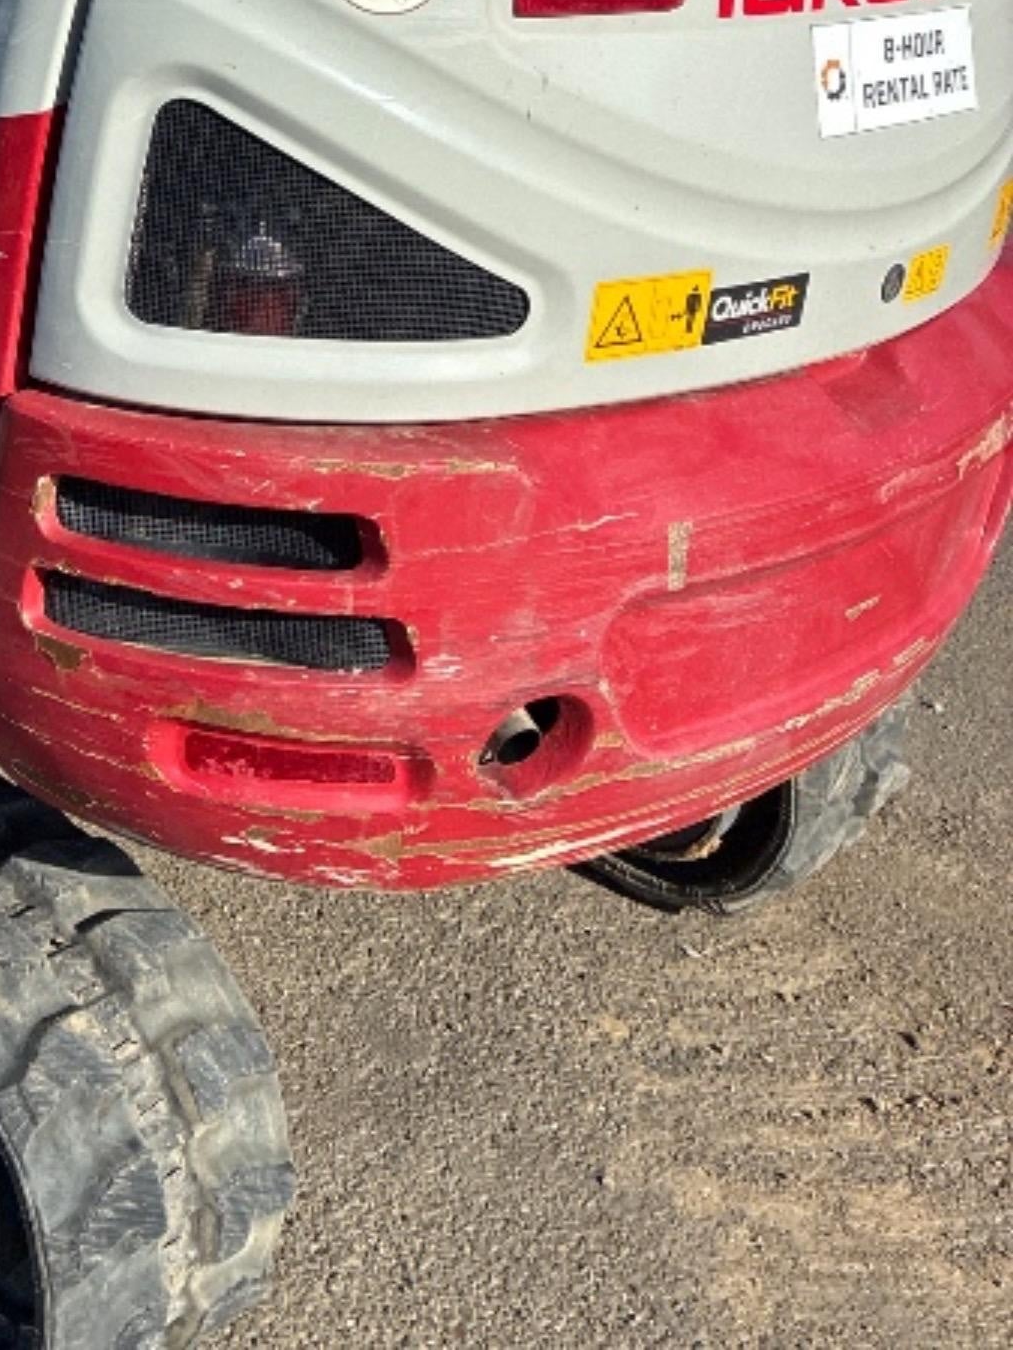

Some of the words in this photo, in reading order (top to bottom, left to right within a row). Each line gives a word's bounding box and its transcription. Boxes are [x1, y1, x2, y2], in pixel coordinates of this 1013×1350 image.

[883, 30, 946, 63] 8-HOUR
[862, 74, 929, 109] RENTAL
[933, 65, 970, 97] RATE
[712, 284, 799, 322] QuickFit
